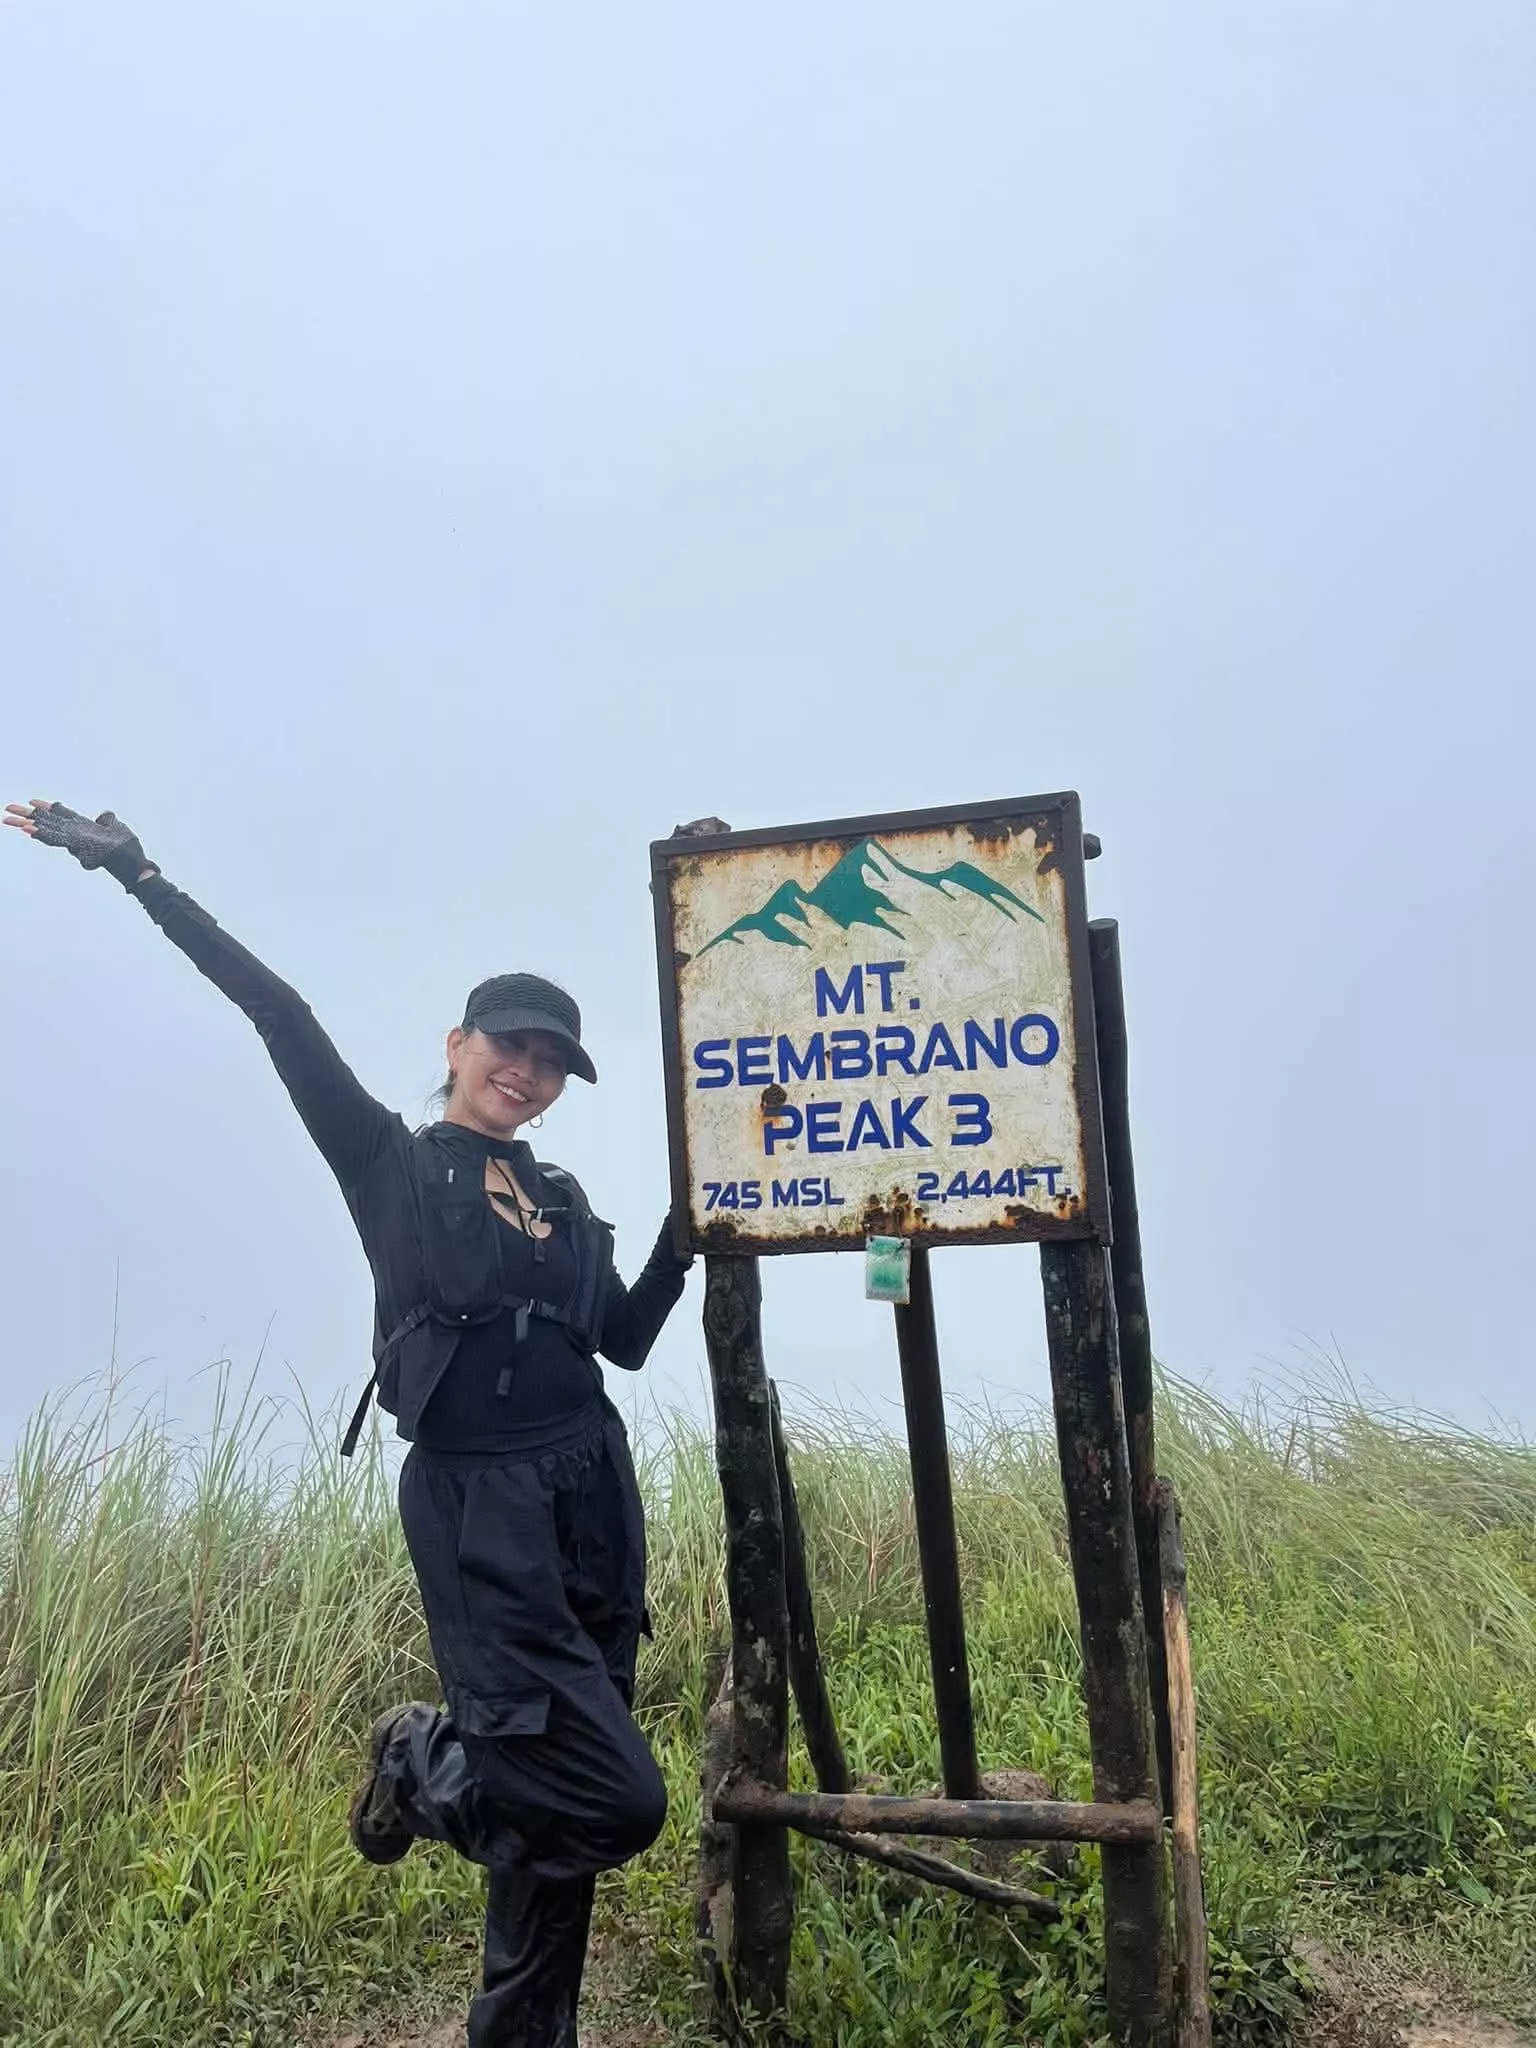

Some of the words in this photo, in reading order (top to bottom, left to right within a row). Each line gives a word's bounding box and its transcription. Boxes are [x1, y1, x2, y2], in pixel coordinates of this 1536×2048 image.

[815, 960, 920, 1017] MT.
[694, 1013, 1060, 1089] SEMBRANO
[762, 1095, 932, 1155] PEAK
[948, 1093, 992, 1146] 3
[702, 1180, 763, 1211] 745
[772, 1177, 845, 1208] MSL
